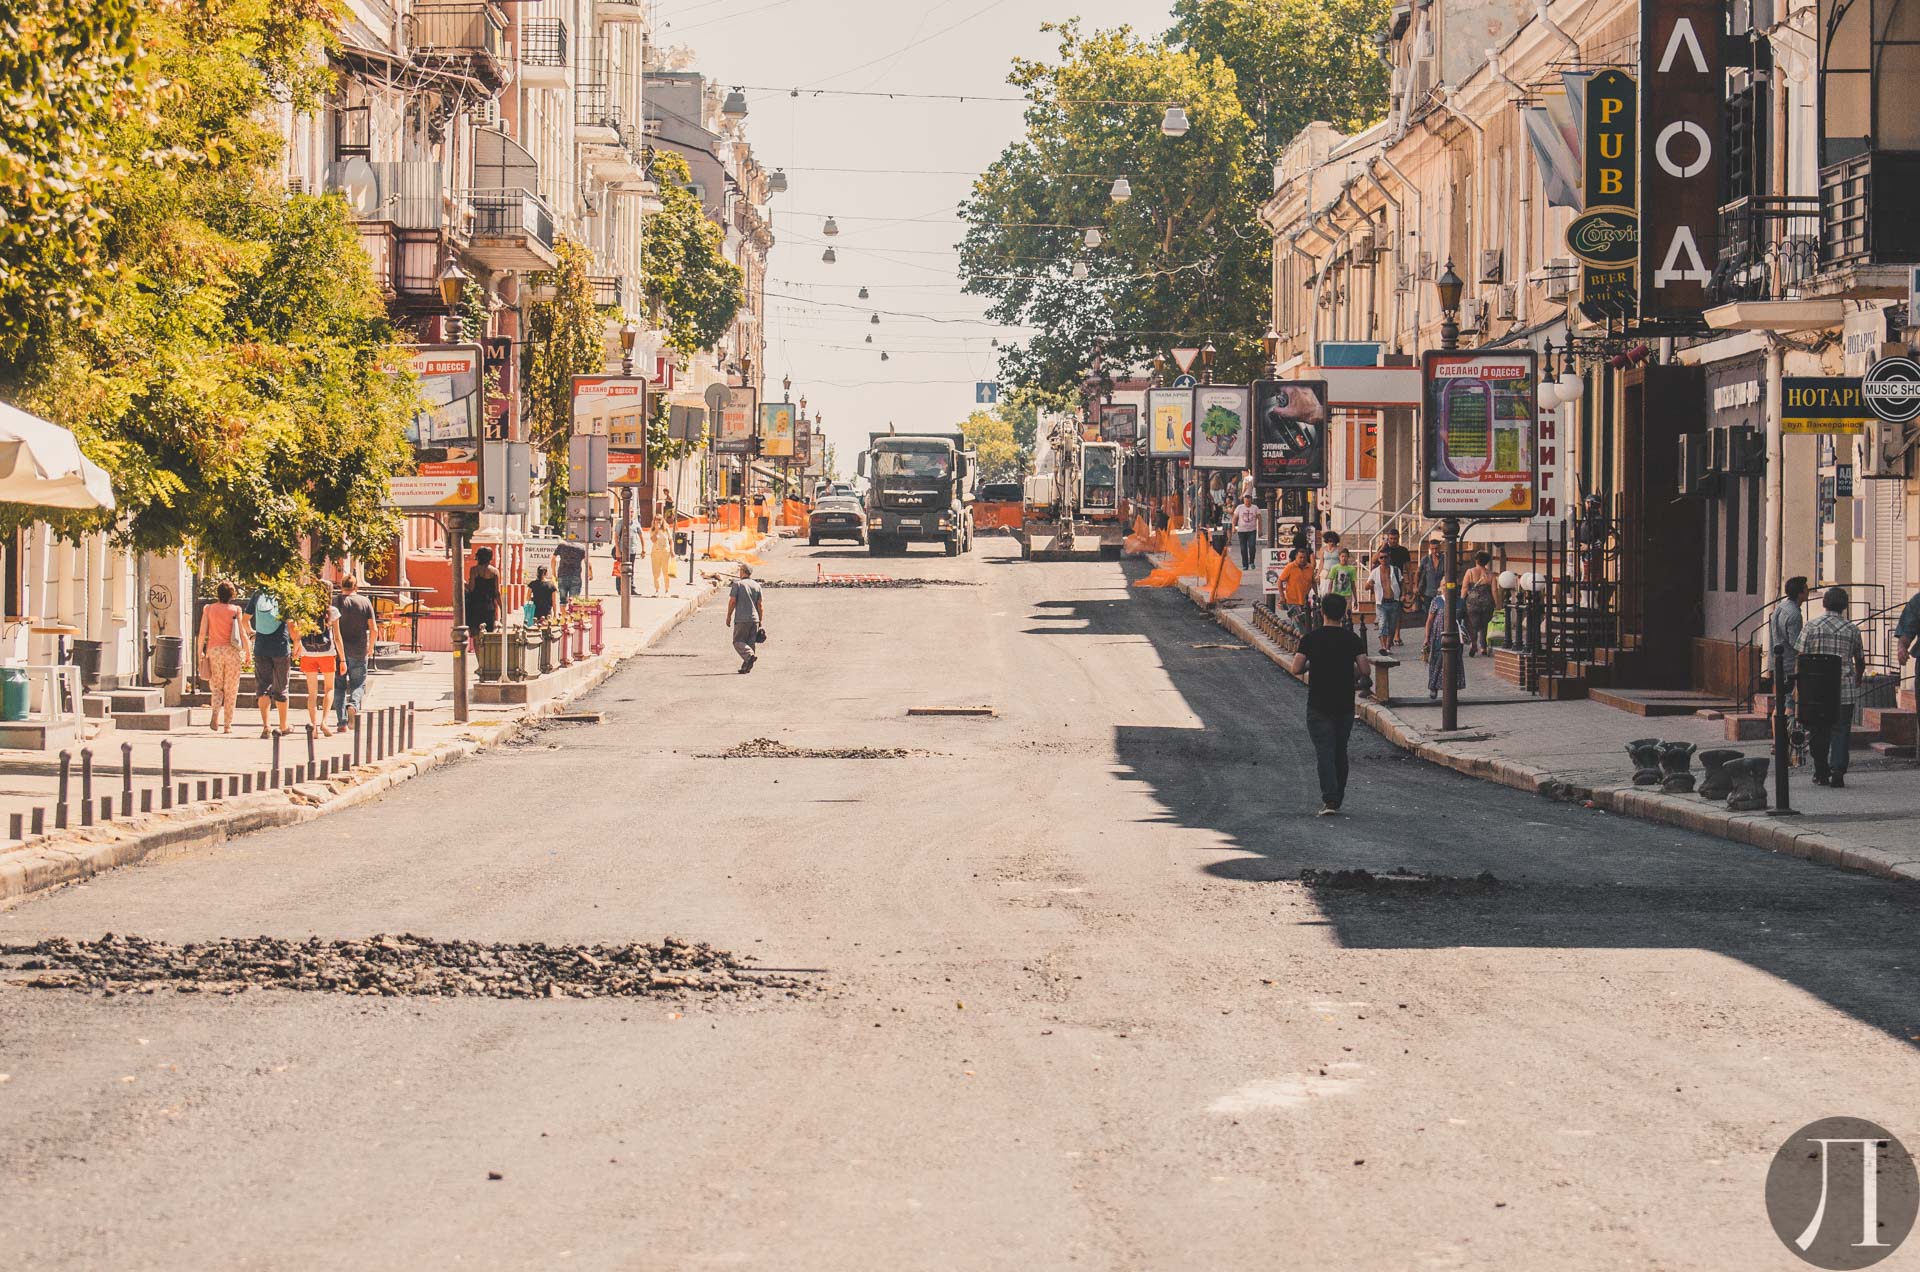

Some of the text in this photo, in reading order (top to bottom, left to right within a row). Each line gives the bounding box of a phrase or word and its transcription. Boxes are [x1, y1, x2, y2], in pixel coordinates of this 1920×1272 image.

[1599, 98, 1624, 194] PUB
[1591, 272, 1627, 286] BEER
[428, 362, 434, 371] В
[436, 361, 465, 371] ОДЕССЕ
[1439, 366, 1521, 378] СДЕЛАНО В ОДЕССЕ
[1865, 384, 1898, 395] MUSIC
[1788, 388, 1867, 407] НОТАРІ
